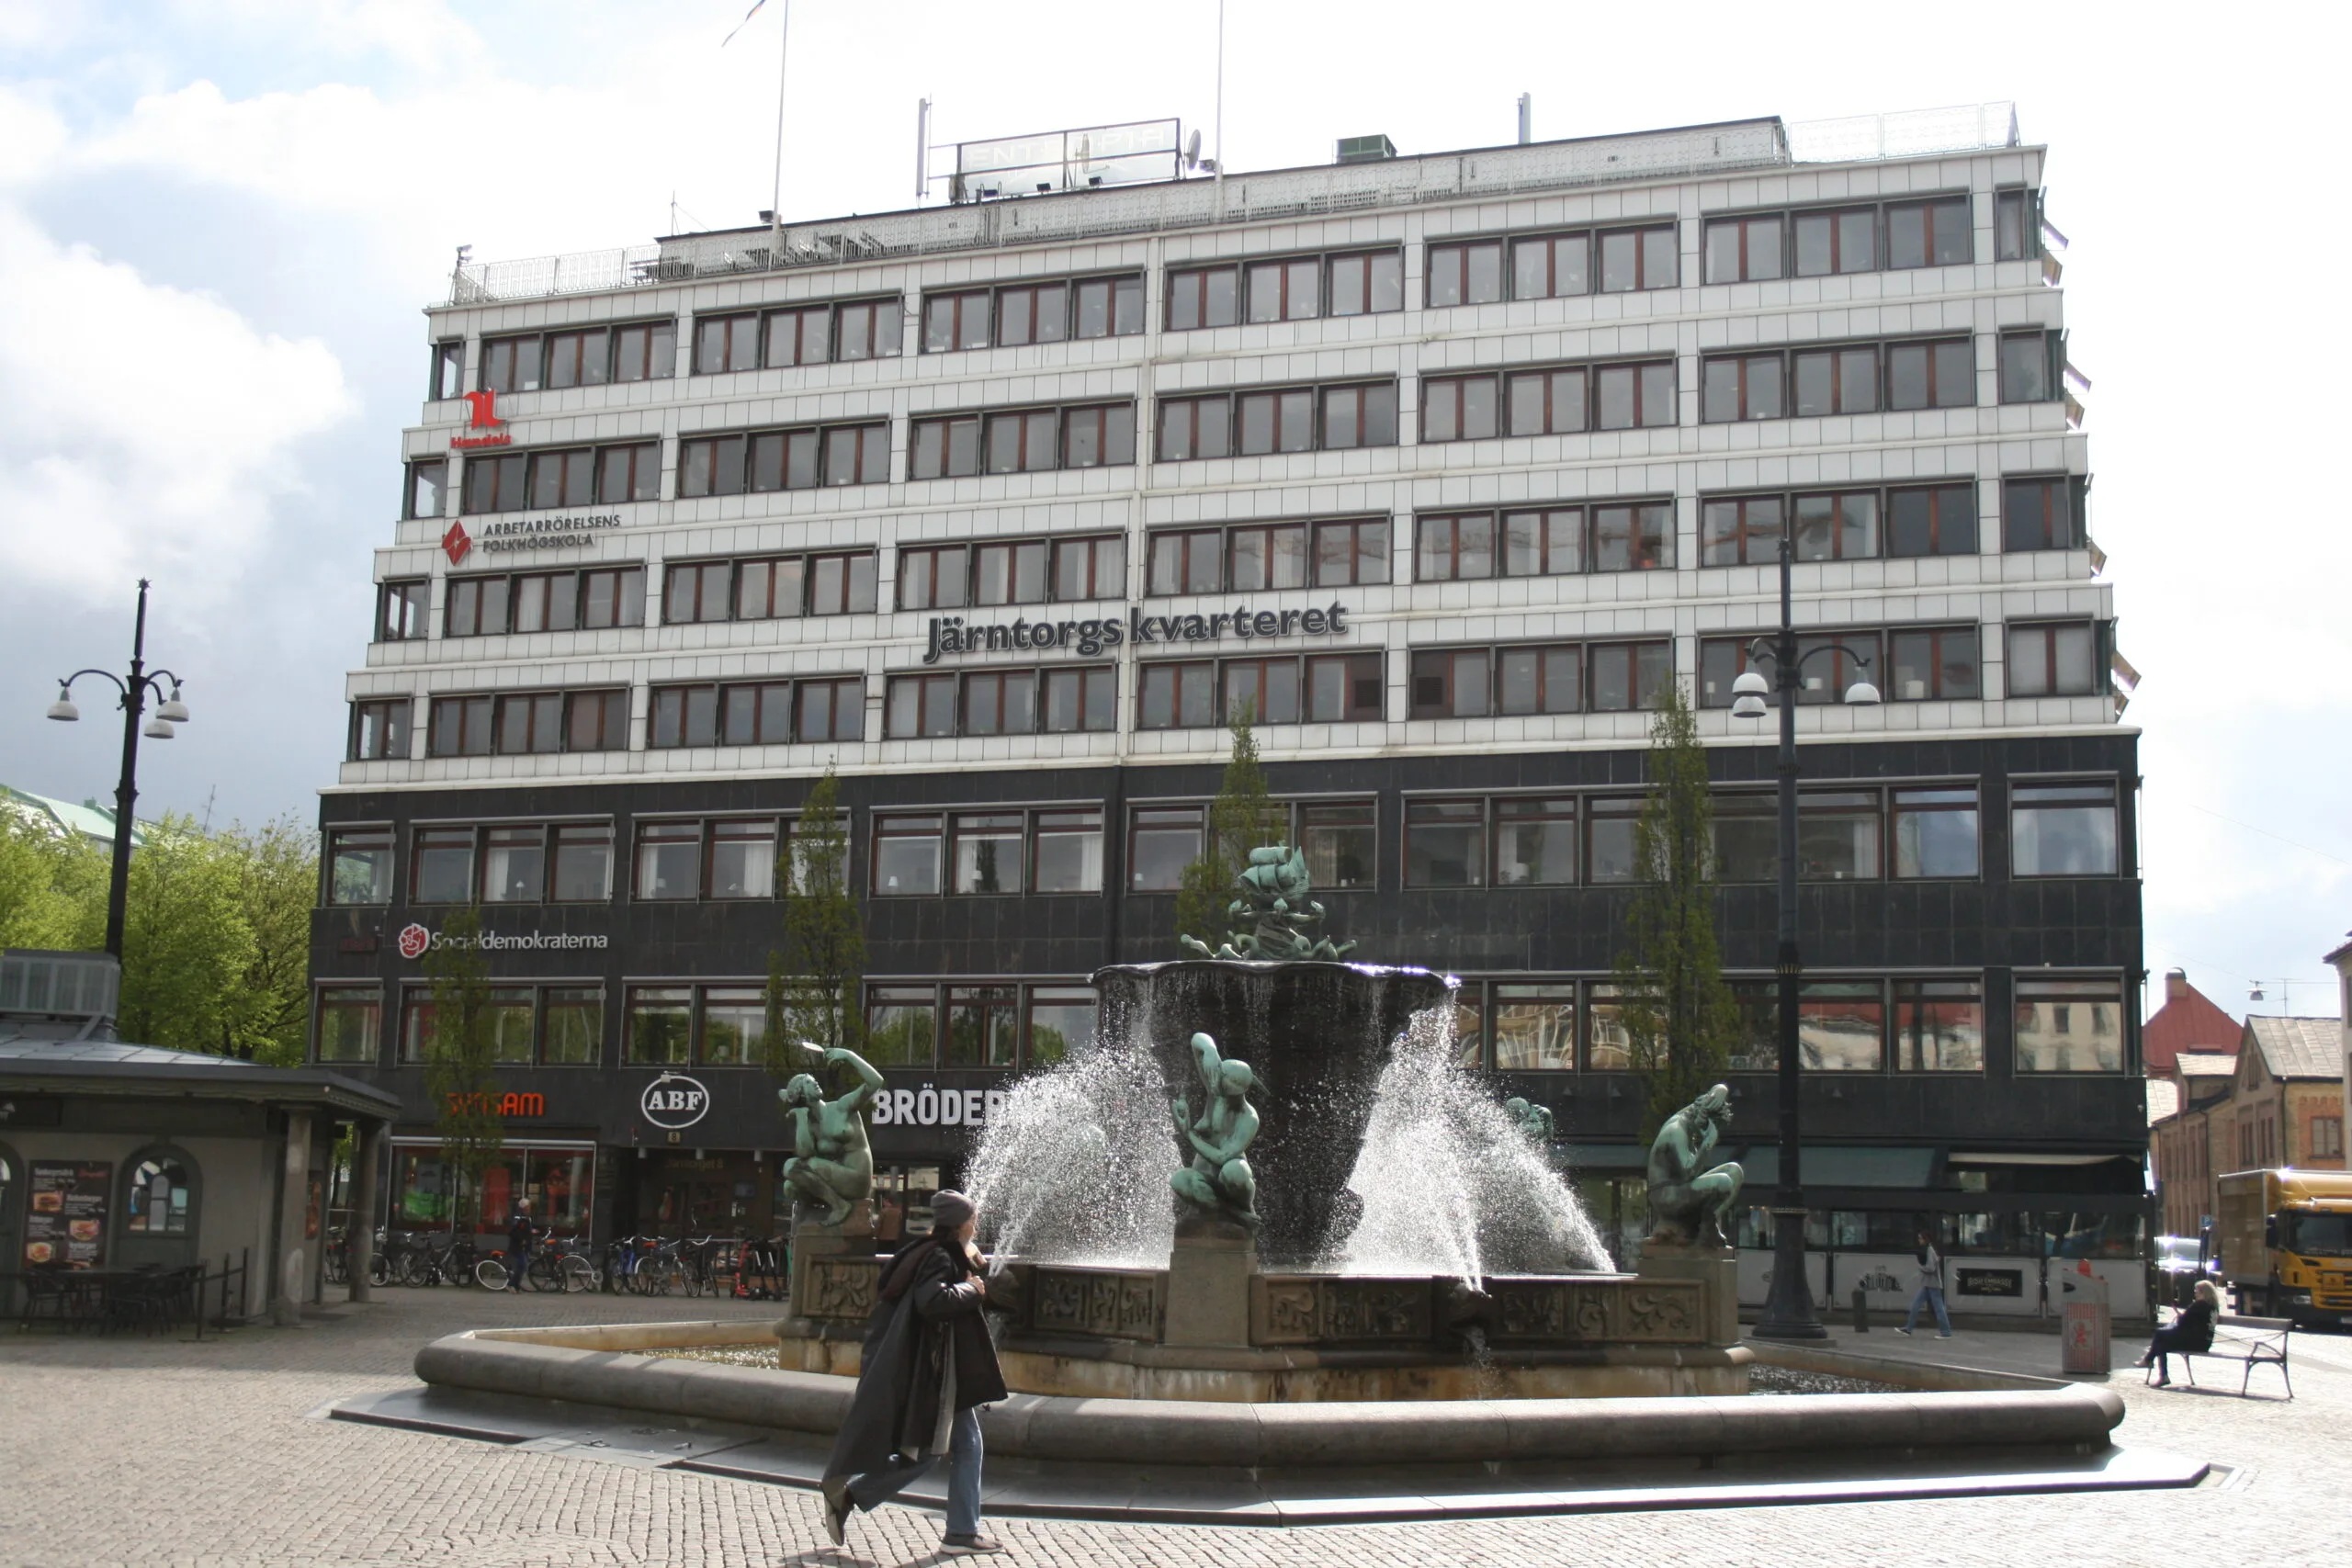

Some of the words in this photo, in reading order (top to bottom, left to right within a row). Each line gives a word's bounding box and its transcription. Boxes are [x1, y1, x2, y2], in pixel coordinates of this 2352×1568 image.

[450, 434, 512, 448] Handels
[484, 514, 621, 536] ARBETARRÖRELSENS
[482, 532, 594, 553] FOLKHÖGSKOLA
[648, 1090, 703, 1111] ABF
